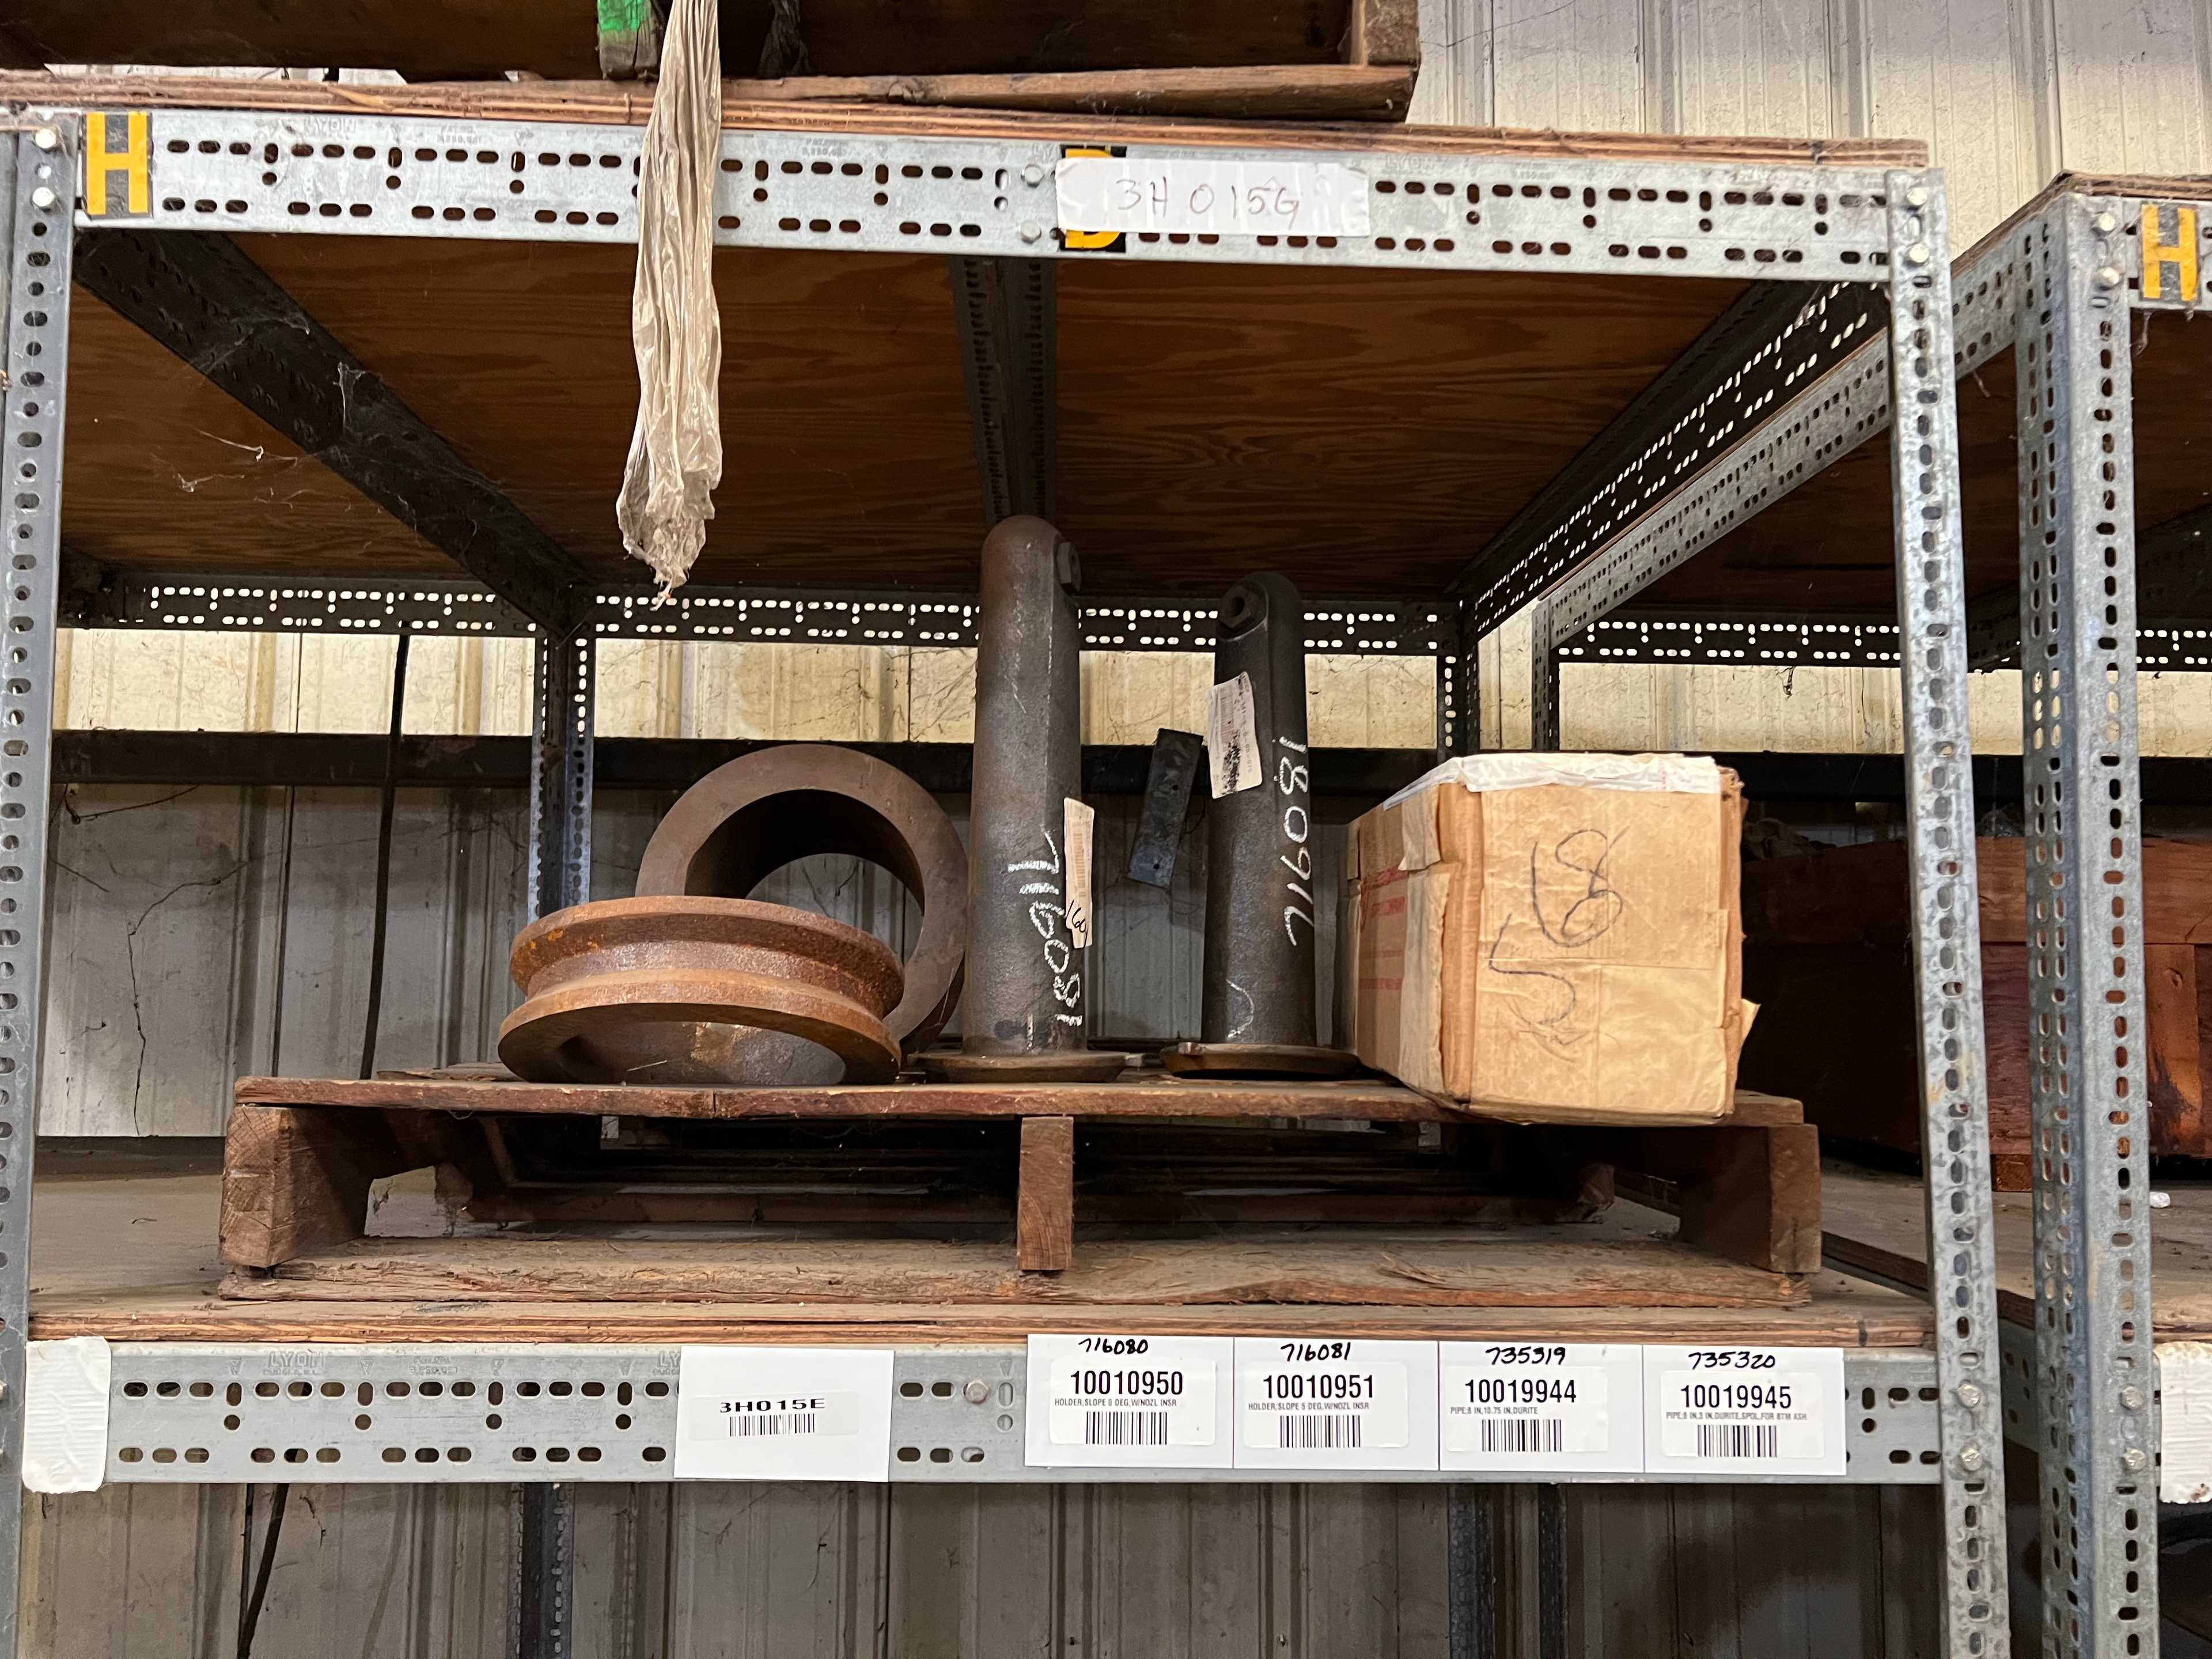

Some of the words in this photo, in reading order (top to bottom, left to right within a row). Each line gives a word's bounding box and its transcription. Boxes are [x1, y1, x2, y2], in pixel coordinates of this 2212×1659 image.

[86, 111, 148, 215] H
[2142, 204, 2197, 301] H
[1078, 1338, 1149, 1355] 716080
[1280, 1342, 1351, 1362] 716081
[1485, 1346, 1566, 1365] 735319
[1688, 1351, 1776, 1369] 735320
[1070, 1370, 1183, 1395] 10010950
[1263, 1374, 1373, 1399] 10010951
[1465, 1379, 1577, 1403] 10019944
[719, 1398, 825, 1413] 3H015E
[1160, 1399, 1177, 1407] INSR
[1681, 1384, 1792, 1409] 10019945
